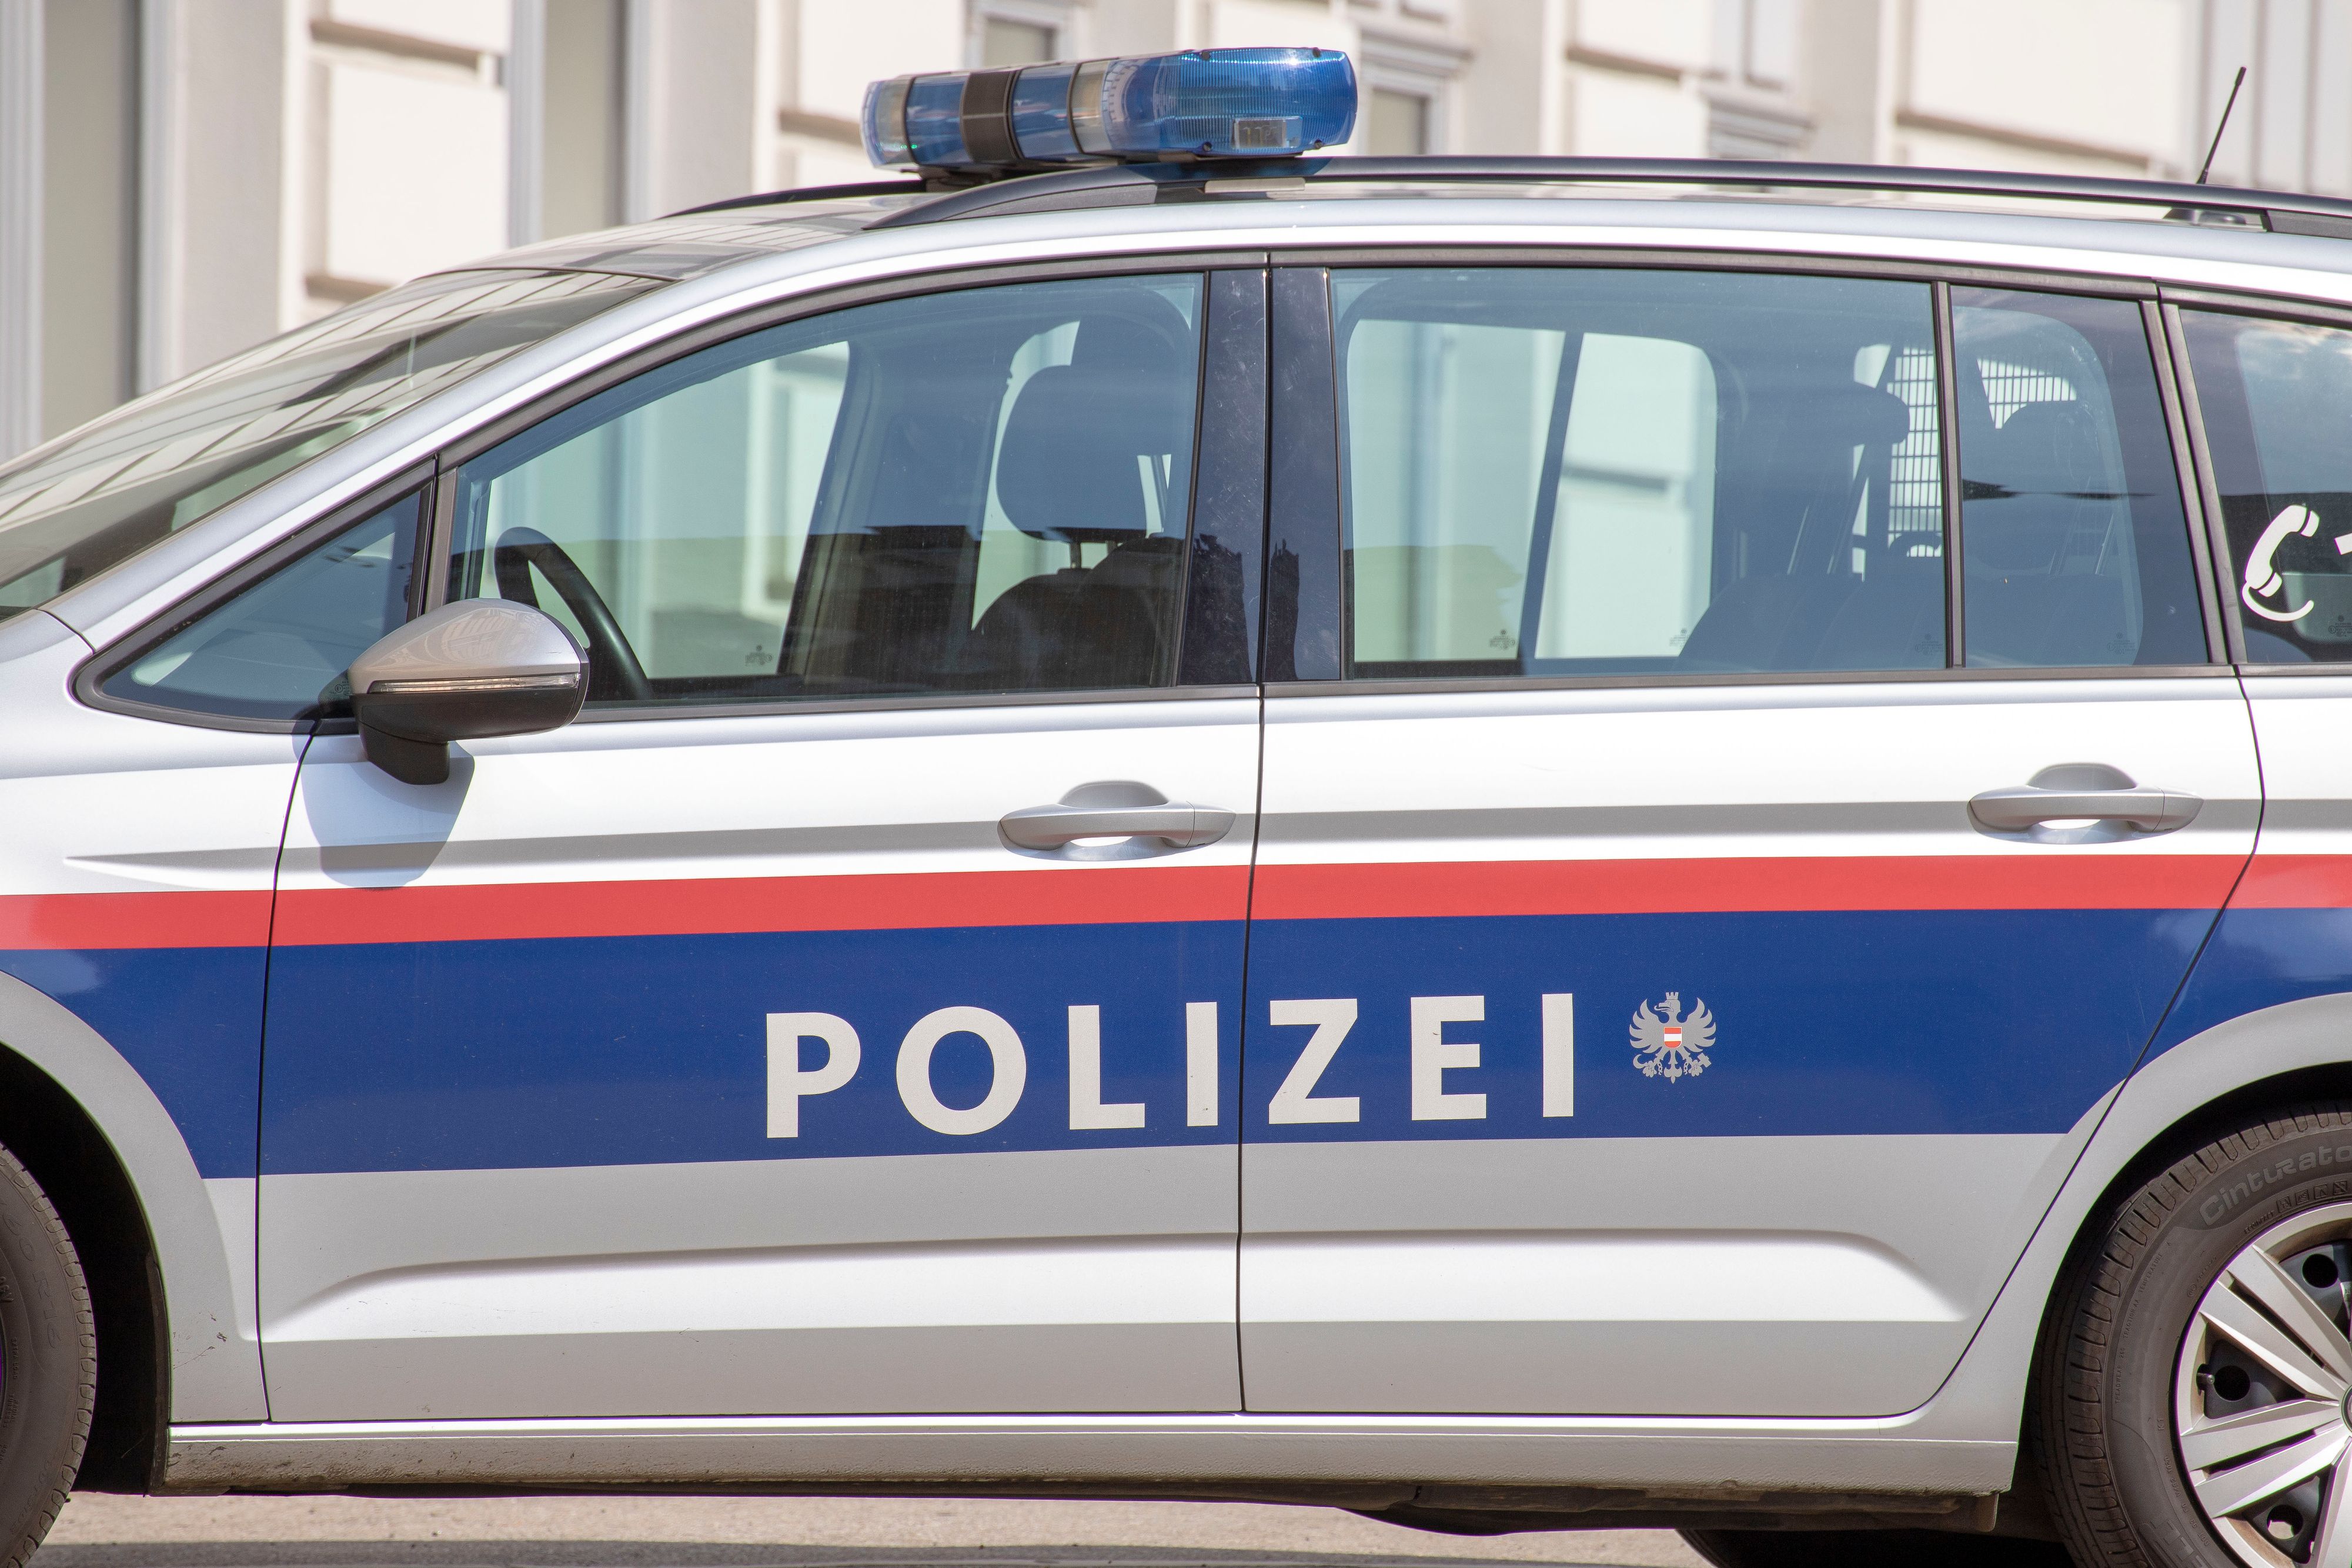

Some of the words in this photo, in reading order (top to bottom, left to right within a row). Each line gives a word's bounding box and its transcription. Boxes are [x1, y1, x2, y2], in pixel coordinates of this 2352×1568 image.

[766, 994, 1574, 1138] POLIZEI
[2123, 1308, 2136, 1339] TRACTION
[2139, 1253, 2163, 1293] TEMPERATURE
[2197, 1532, 2210, 1546] DOT
